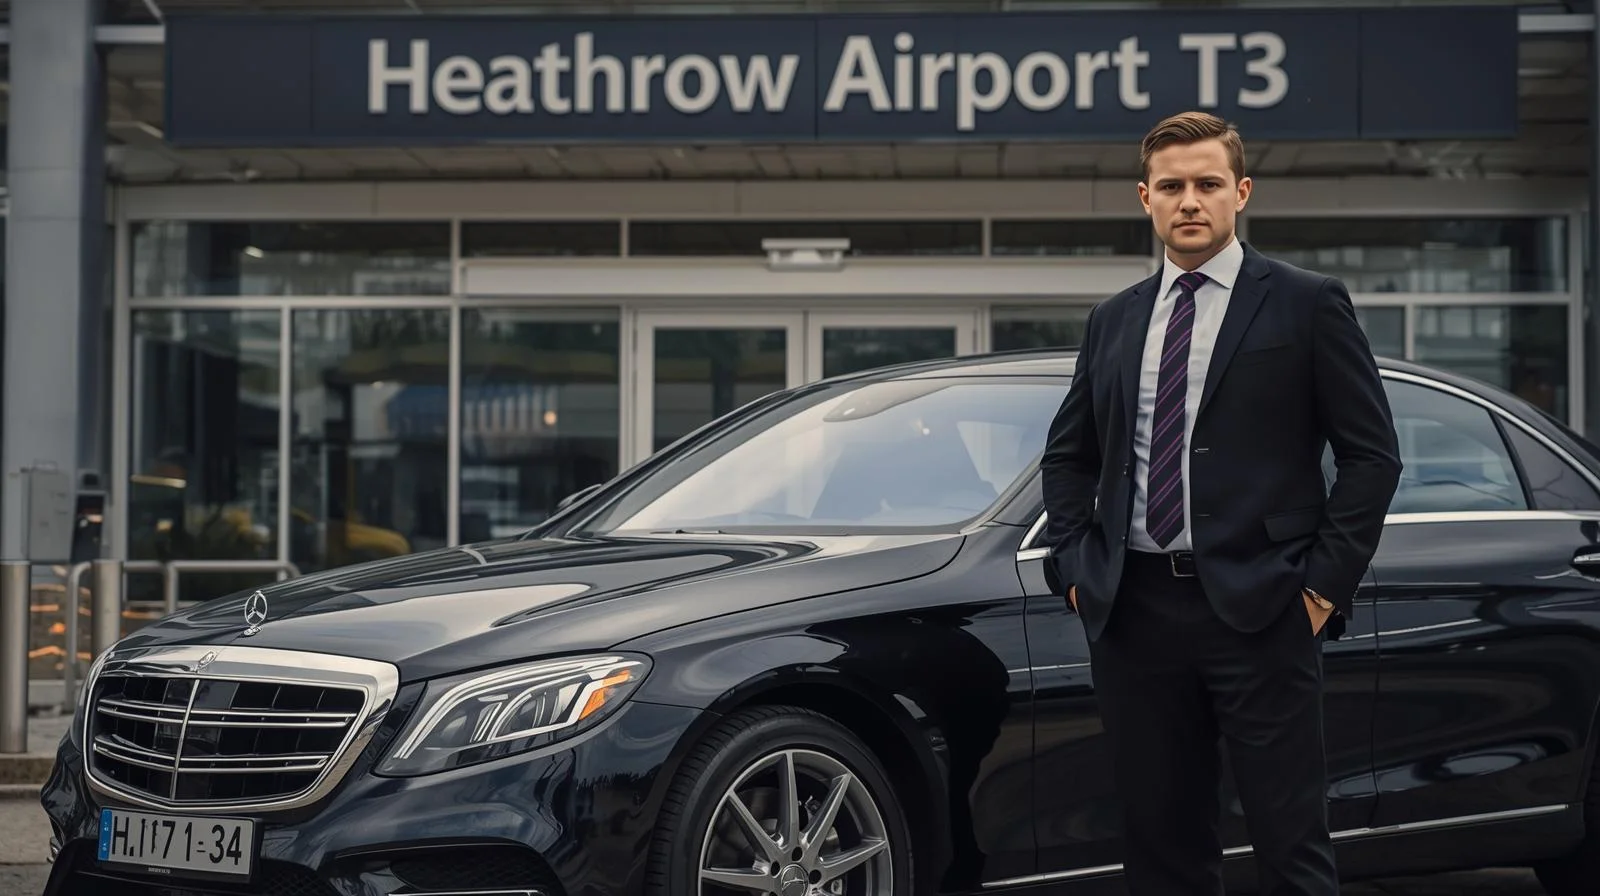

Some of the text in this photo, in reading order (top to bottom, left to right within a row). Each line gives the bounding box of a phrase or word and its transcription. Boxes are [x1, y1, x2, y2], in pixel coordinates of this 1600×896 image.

[367, 31, 1289, 130] Heathrow Airport T3
